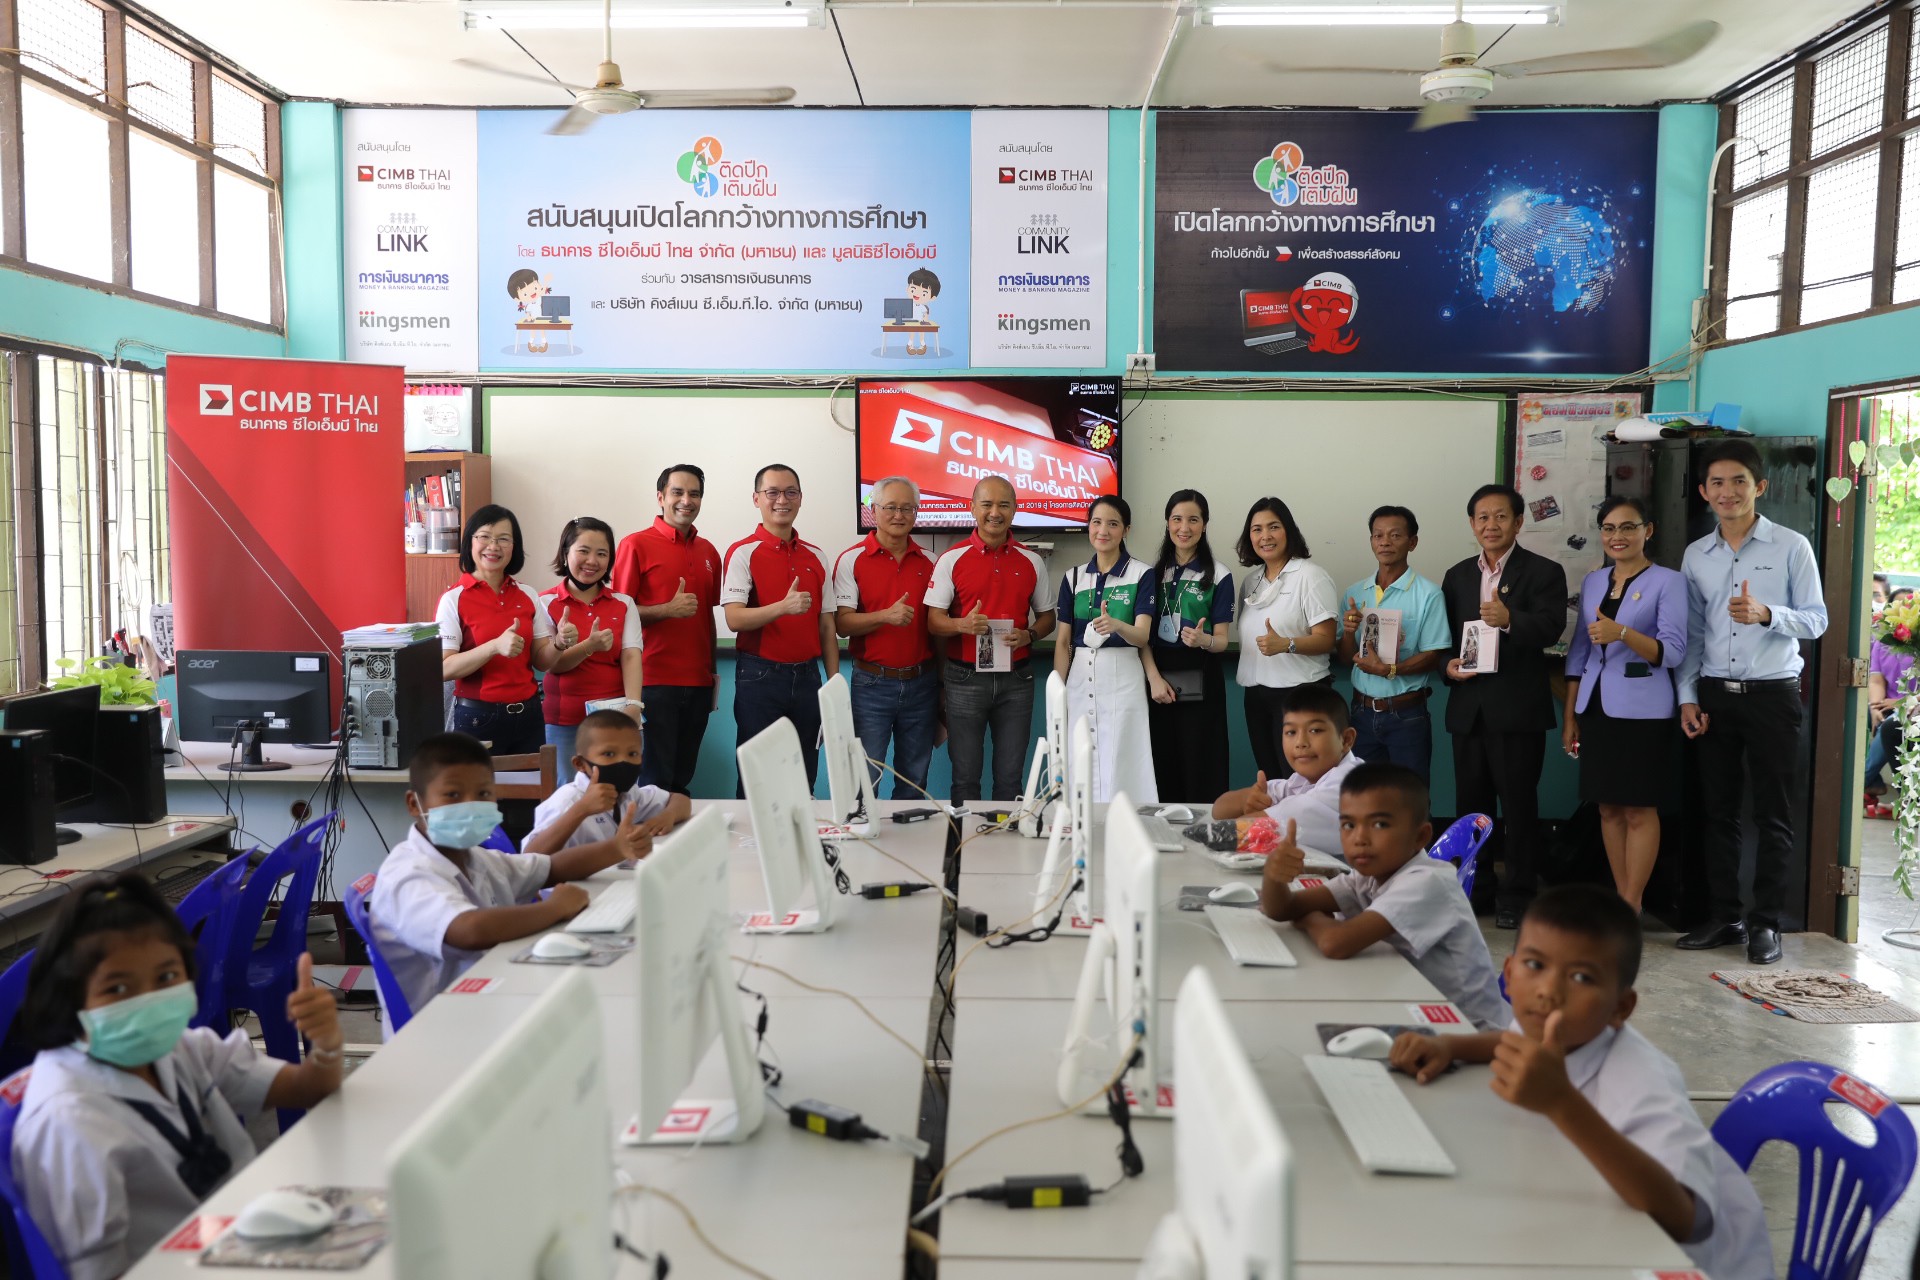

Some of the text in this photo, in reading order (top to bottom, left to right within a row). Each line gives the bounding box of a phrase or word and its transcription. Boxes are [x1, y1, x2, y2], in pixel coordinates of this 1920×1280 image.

[356, 140, 411, 154] สนับสนุนโดย
[998, 141, 1053, 155] สนับสนุนโดย
[377, 168, 451, 181] CIMB THAI
[719, 159, 770, 179] ติดปีก
[1018, 169, 1093, 182] CIMB THAI
[1298, 166, 1348, 185] ติดปีก
[437, 181, 451, 191] ไทย
[723, 179, 778, 197] เติมฝัน
[1078, 182, 1093, 192] ไทย
[1301, 185, 1357, 204] เติมฝัน
[528, 201, 926, 234] สนับสนุนเปิดโลกกว้างทางการศึกษา
[1175, 208, 1435, 232] เปิดโลกกว้างทางการศึกษา
[376, 224, 429, 234] COMMUNITY
[1017, 226, 1071, 236] COMMUNITY
[378, 234, 428, 252] LINK
[1018, 236, 1069, 253] LINK
[517, 242, 936, 262] โดย ธนาคาร ซีไอเอ็มบี ไทย จำกัด (มหาชน) และ มูลนิธิซีไอเอ็มบี
[1210, 245, 1270, 259] ก้าวไปอีกขั้น
[359, 270, 449, 284] การเงินธนาคาร
[641, 272, 812, 285] ร่วมกับ วารสารการเงินธนาคาร
[998, 272, 1091, 286] การเงินธนาคาร
[1321, 280, 1343, 290] CIMB
[591, 300, 606, 309] และ
[610, 296, 646, 310] บริษัท
[650, 296, 698, 310] คิงส์เมน
[777, 297, 809, 311] จำกัด
[815, 299, 862, 313] (มหาชน)
[1258, 304, 1275, 312] CIMB
[240, 390, 378, 415] CIMB THAI
[239, 417, 378, 432] ธนาคาร ซีไอเอ็มบี ไทย
[950, 431, 1100, 488] CIMB THAI
[1014, 473, 1077, 499] ซีไอเอ็มบี
[187, 659, 218, 669] acer
